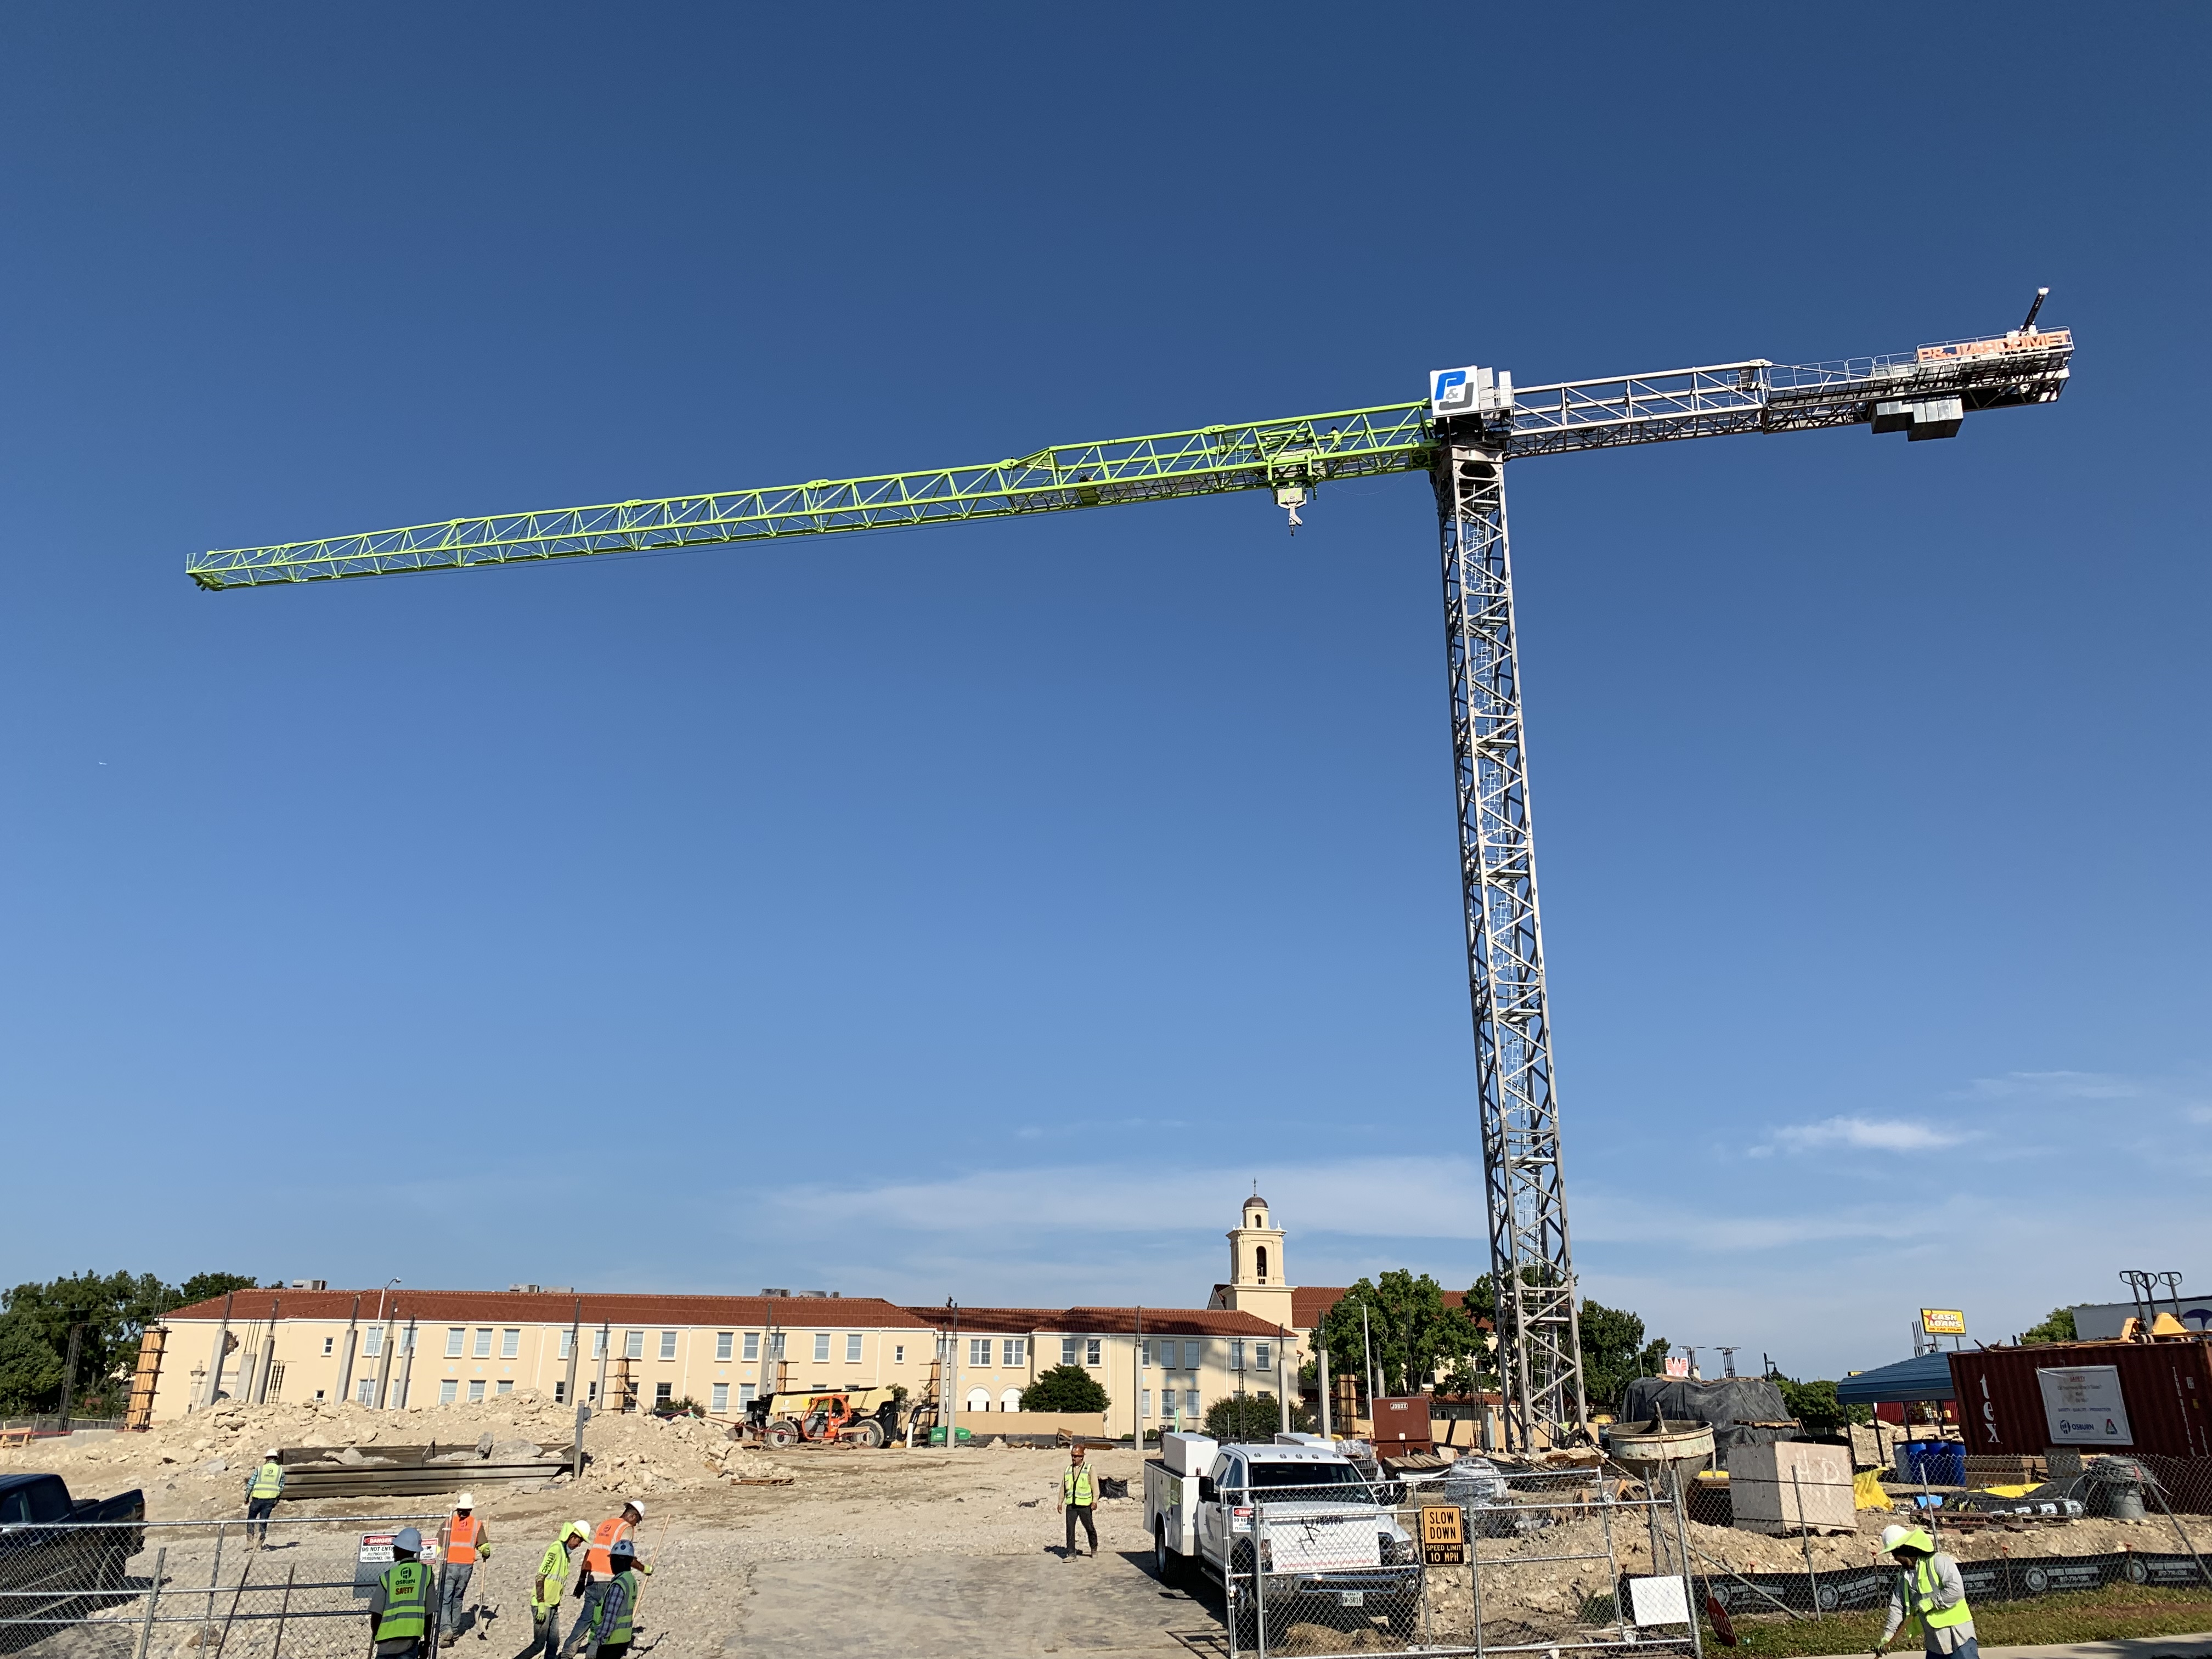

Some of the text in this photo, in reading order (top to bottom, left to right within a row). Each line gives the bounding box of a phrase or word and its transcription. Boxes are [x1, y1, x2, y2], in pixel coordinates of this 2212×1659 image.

[1434, 370, 1474, 411] P&J
[1929, 1319, 1962, 1328] LOANS
[1429, 1511, 1454, 1524] SLOW
[1430, 1527, 1456, 1539] DOWN
[1430, 1552, 1459, 1562] 10 MPH
[395, 1587, 414, 1595] SAFETY
[1711, 1611, 1734, 1638] STOP
